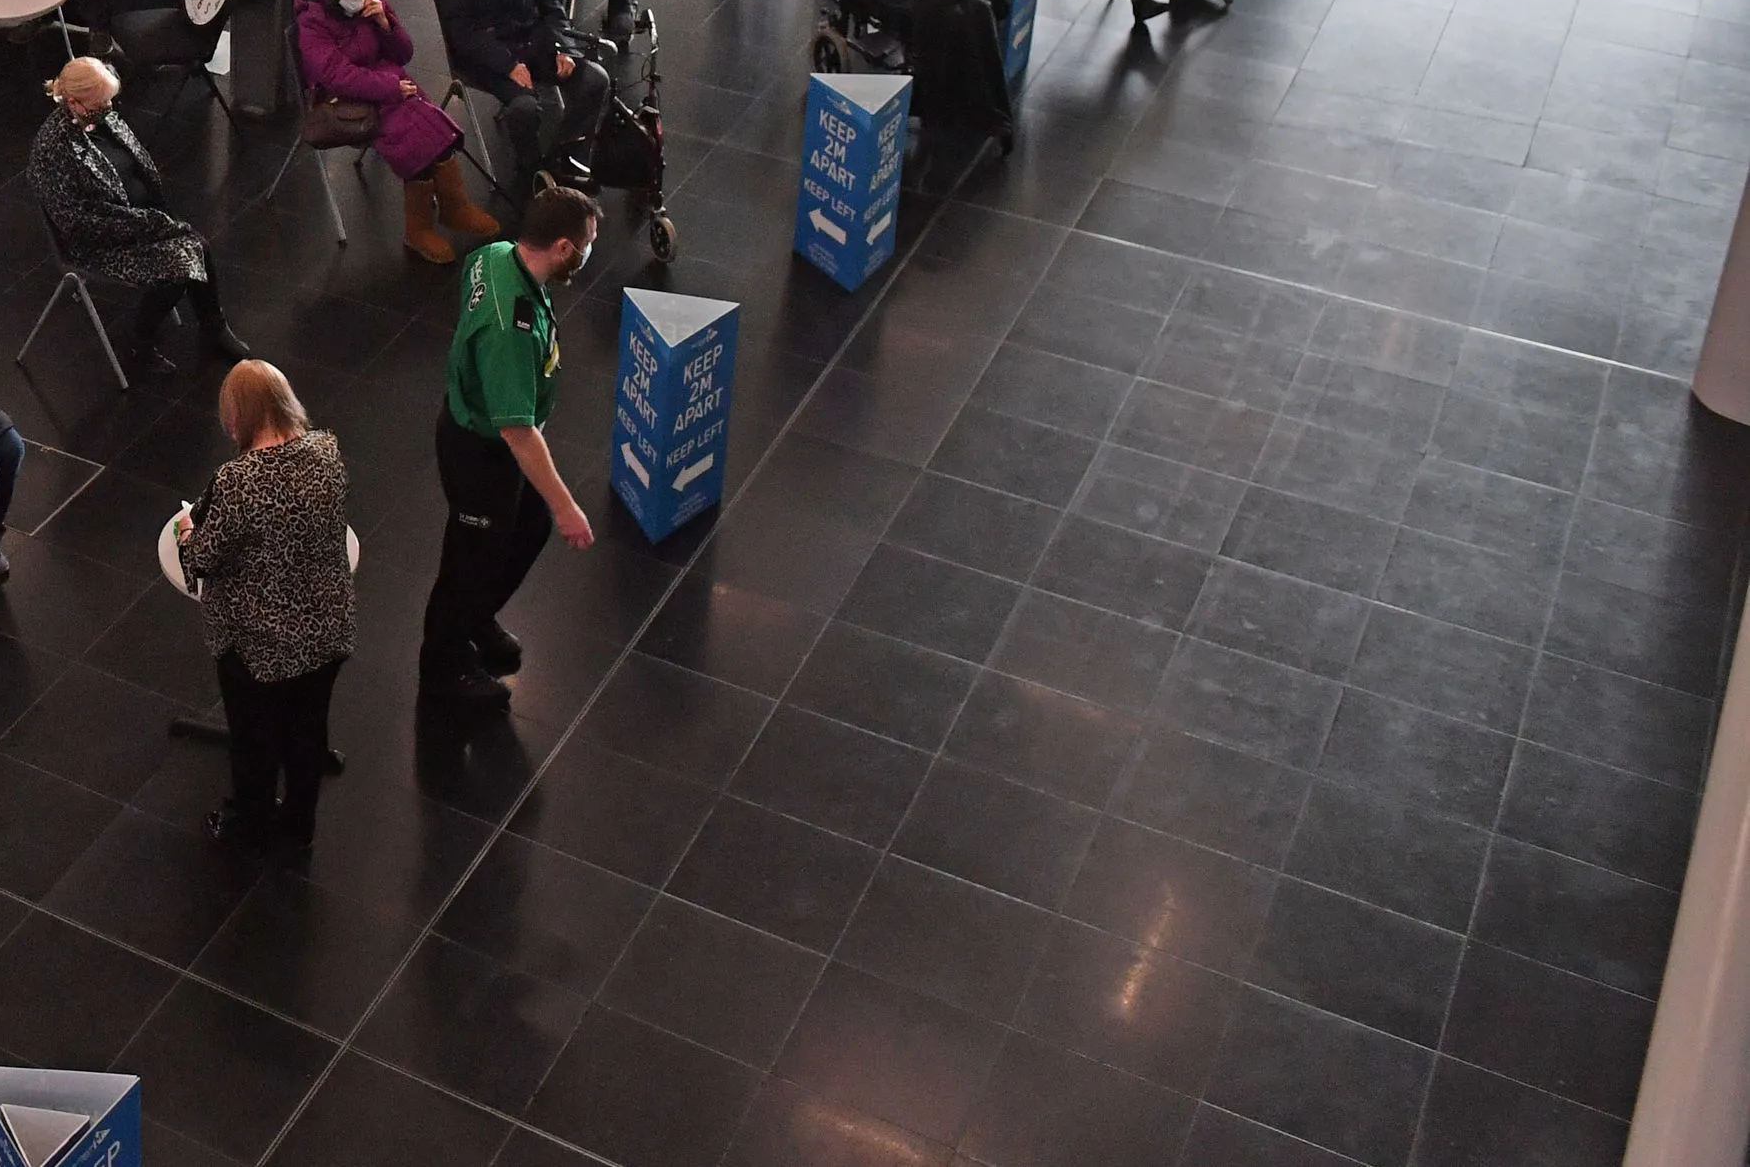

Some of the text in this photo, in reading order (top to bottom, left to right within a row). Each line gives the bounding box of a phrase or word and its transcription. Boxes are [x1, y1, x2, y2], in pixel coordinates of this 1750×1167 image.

[819, 109, 857, 143] KEEP
[877, 112, 902, 149] KEEP
[810, 149, 856, 191] APART
[824, 135, 847, 163] 2M
[869, 151, 900, 193] APART
[803, 177, 857, 222] KEEP LEFT
[629, 331, 658, 375] KEEP
[683, 343, 723, 385] KEEP
[632, 362, 650, 397] 2M
[688, 371, 713, 403] 2M
[622, 375, 659, 430] APART
[673, 387, 724, 435] APART
[617, 404, 658, 466] KEEP LEFT
[666, 419, 725, 469] KEEP LEFT
